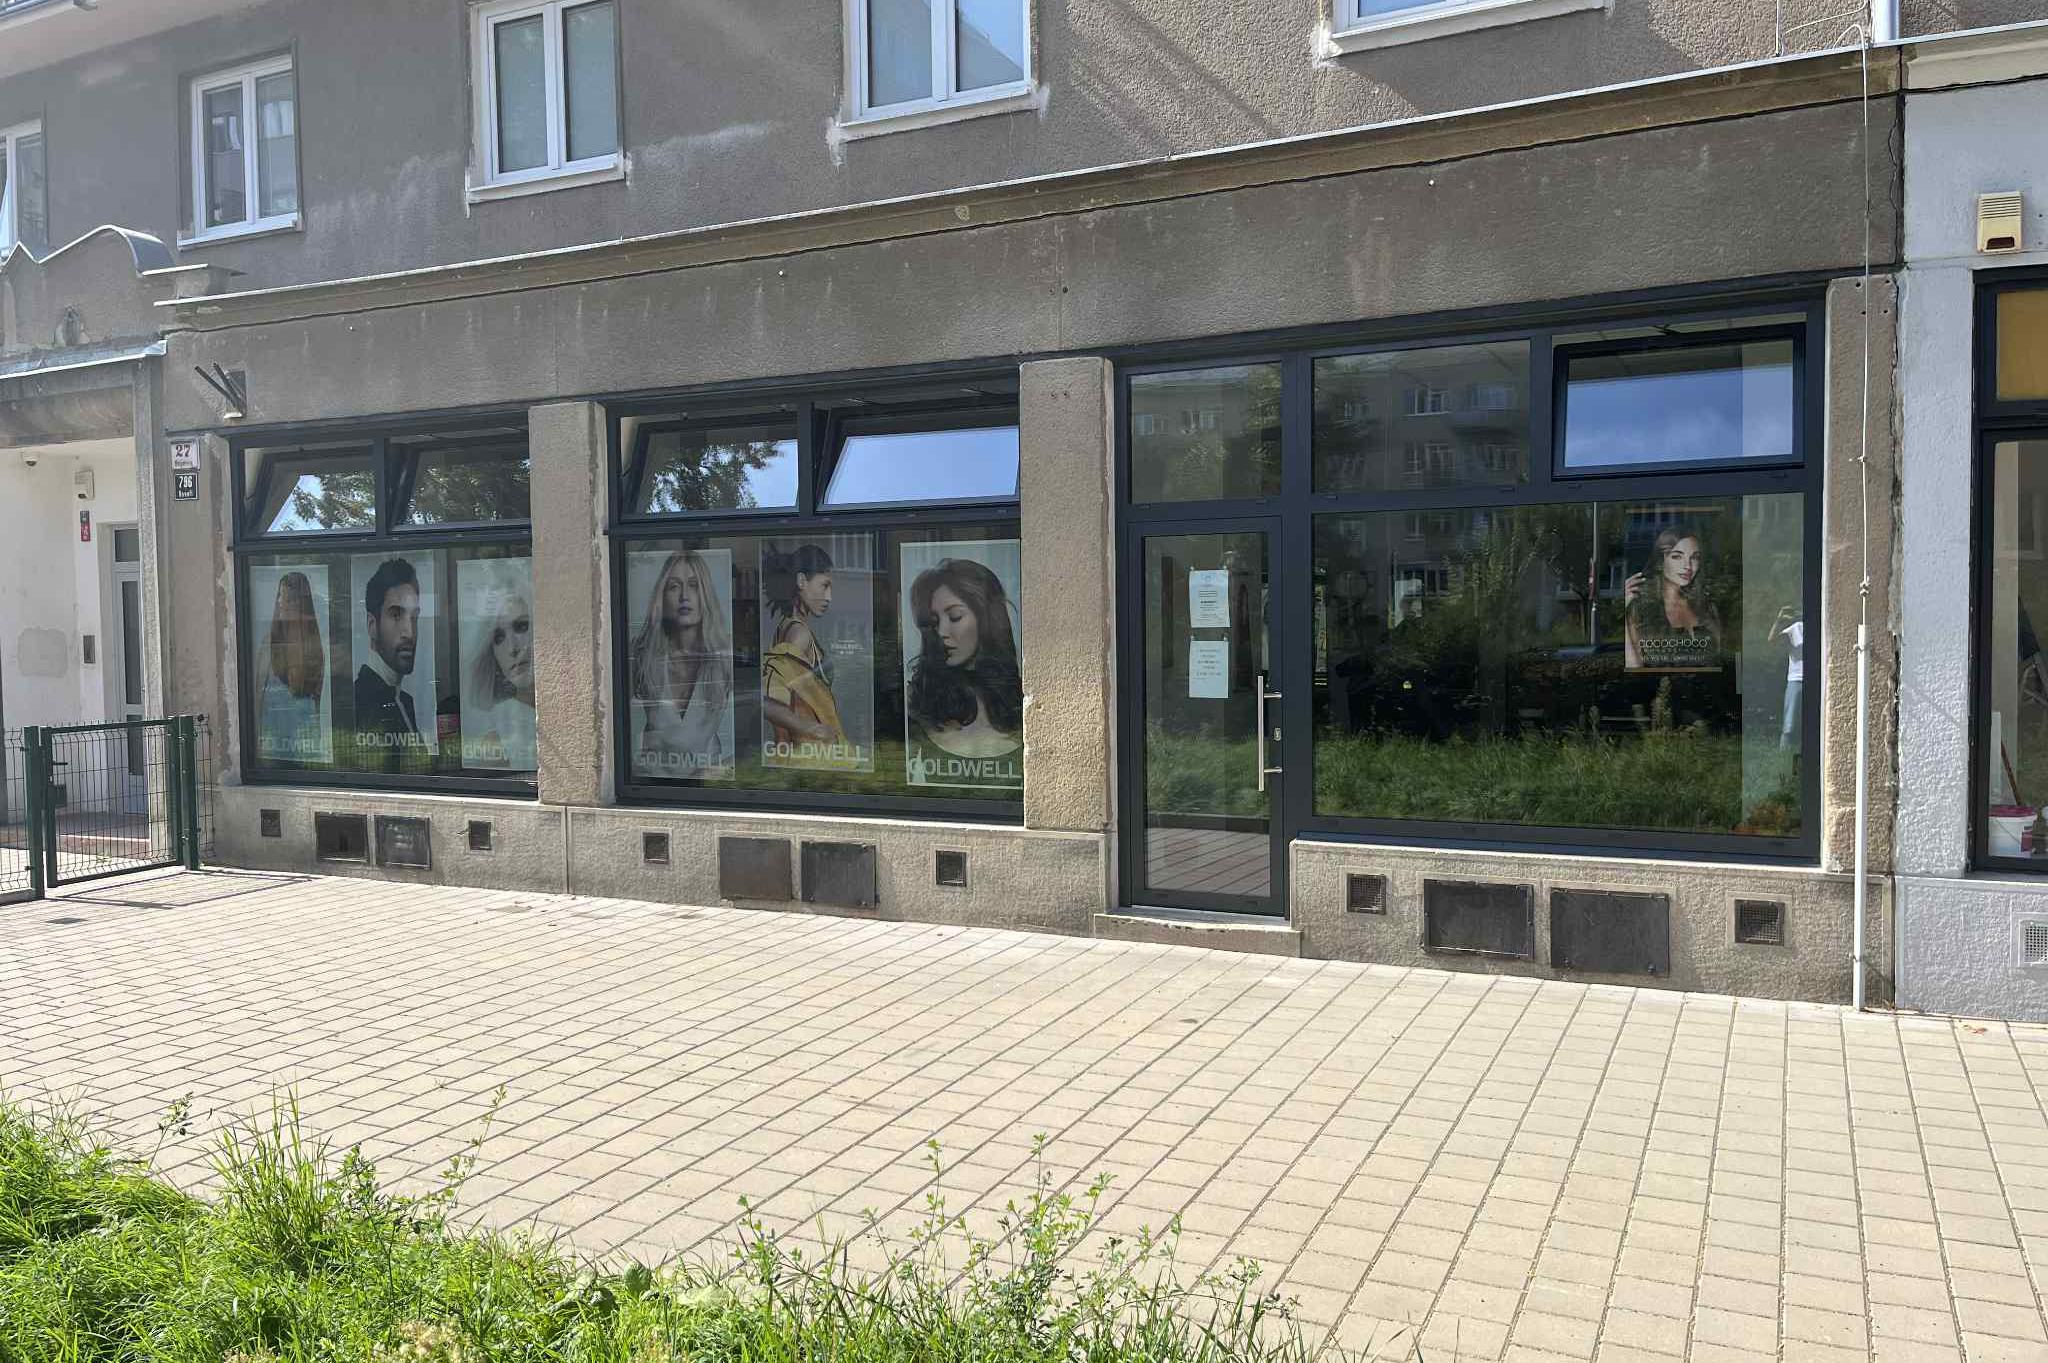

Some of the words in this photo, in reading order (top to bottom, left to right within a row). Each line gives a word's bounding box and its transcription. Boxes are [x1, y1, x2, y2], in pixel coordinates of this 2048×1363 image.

[175, 444, 191, 458] 27
[1638, 638, 1708, 648] COCOCHOCO
[257, 736, 328, 755] GOLDWEL
[355, 732, 433, 747] GOLDWELL
[463, 743, 535, 761] GOLDWEL
[636, 750, 730, 770] GOLDWELL
[764, 740, 869, 762] GOLDWELL
[909, 757, 1022, 778] GOLDWELL
